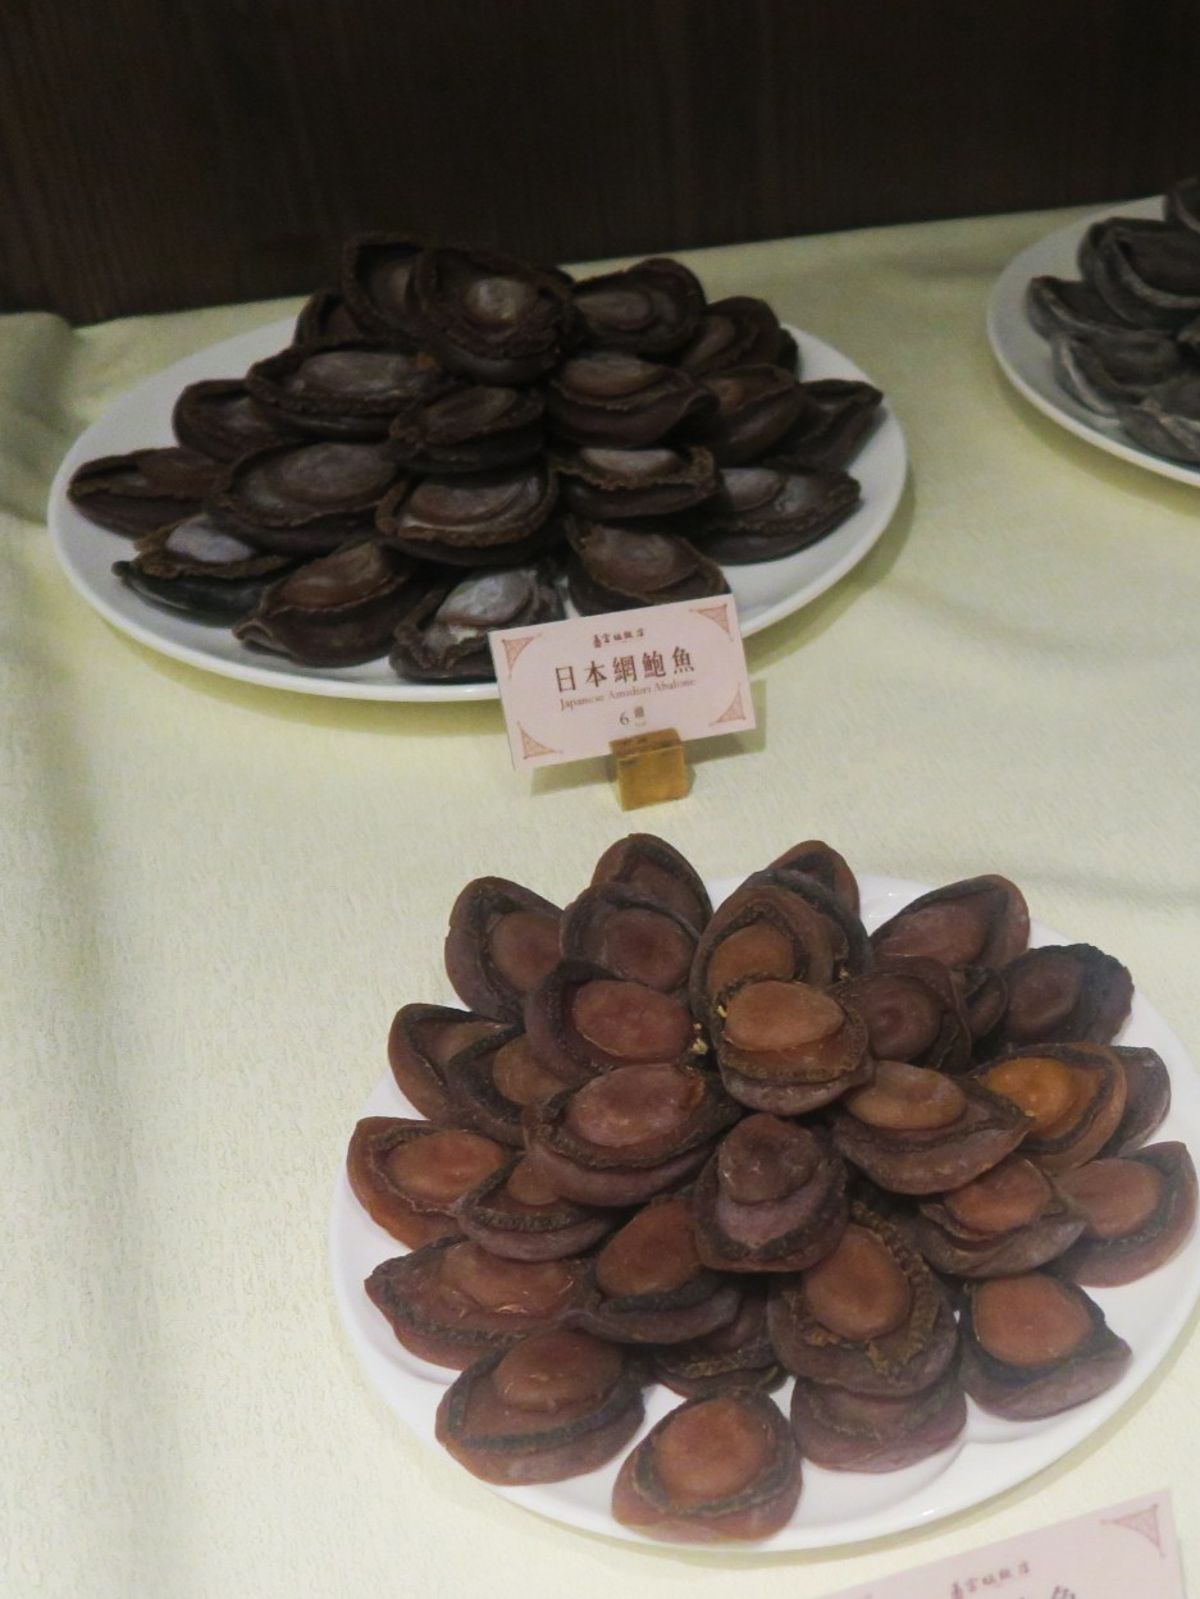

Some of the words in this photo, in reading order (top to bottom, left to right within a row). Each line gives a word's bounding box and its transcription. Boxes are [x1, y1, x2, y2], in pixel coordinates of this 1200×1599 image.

[555, 646, 695, 693] 日本網鮑魚
[619, 711, 630, 726] 6
